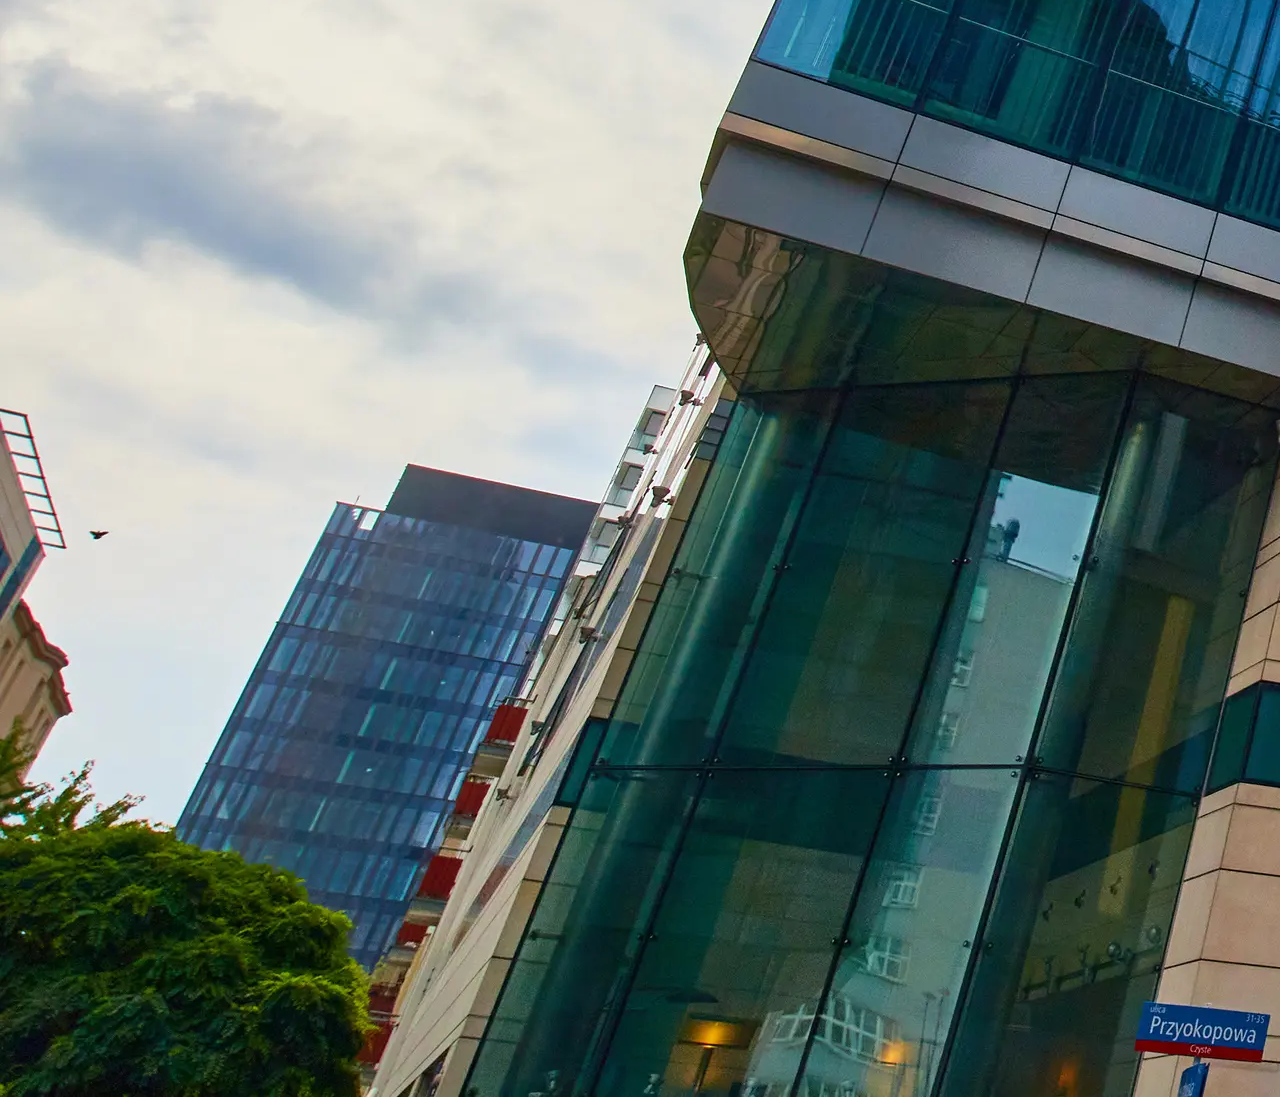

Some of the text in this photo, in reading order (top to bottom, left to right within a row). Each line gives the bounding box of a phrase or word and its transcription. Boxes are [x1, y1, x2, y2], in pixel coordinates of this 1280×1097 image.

[1150, 1005, 1166, 1014] ulica
[1149, 1015, 1256, 1044] Przyokopowa
[1189, 1044, 1212, 1056] Czyste
